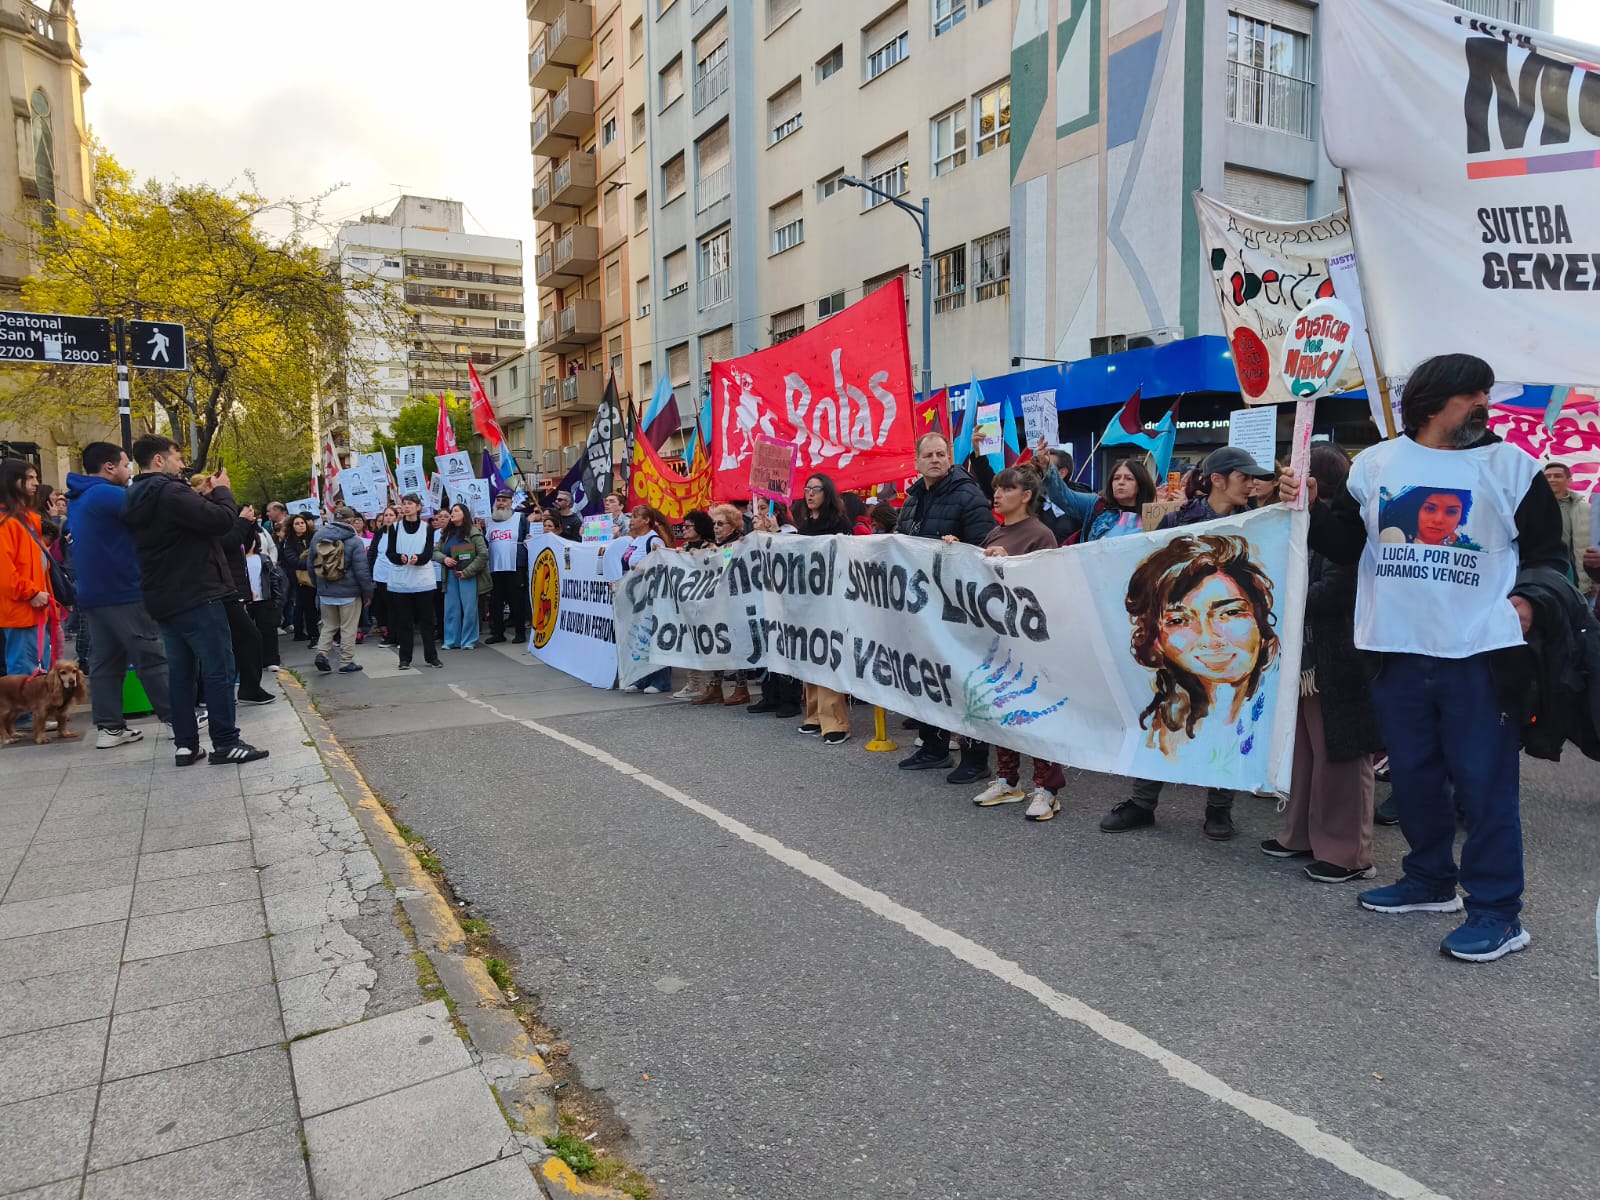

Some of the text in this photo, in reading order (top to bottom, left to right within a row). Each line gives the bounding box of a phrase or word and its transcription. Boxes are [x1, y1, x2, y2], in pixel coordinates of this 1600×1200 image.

[1477, 204, 1572, 244] SUTEBA
[1330, 253, 1355, 267] JUSTI
[1482, 251, 1600, 291] GENE
[0, 314, 62, 329] Peatonal
[0, 328, 77, 345] San Martín
[1303, 338, 1324, 353] POR
[0, 345, 100, 362] 2700 2800
[1283, 348, 1344, 380] NANCY
[1382, 545, 1478, 569] LUCÍA, POR VOS
[844, 558, 929, 615] somos
[1376, 563, 1480, 587] JURAMOS VENCER
[561, 579, 582, 600] JUSTICIA
[582, 580, 589, 602] ES
[590, 581, 614, 605] PERPET
[853, 636, 952, 707] vencer
